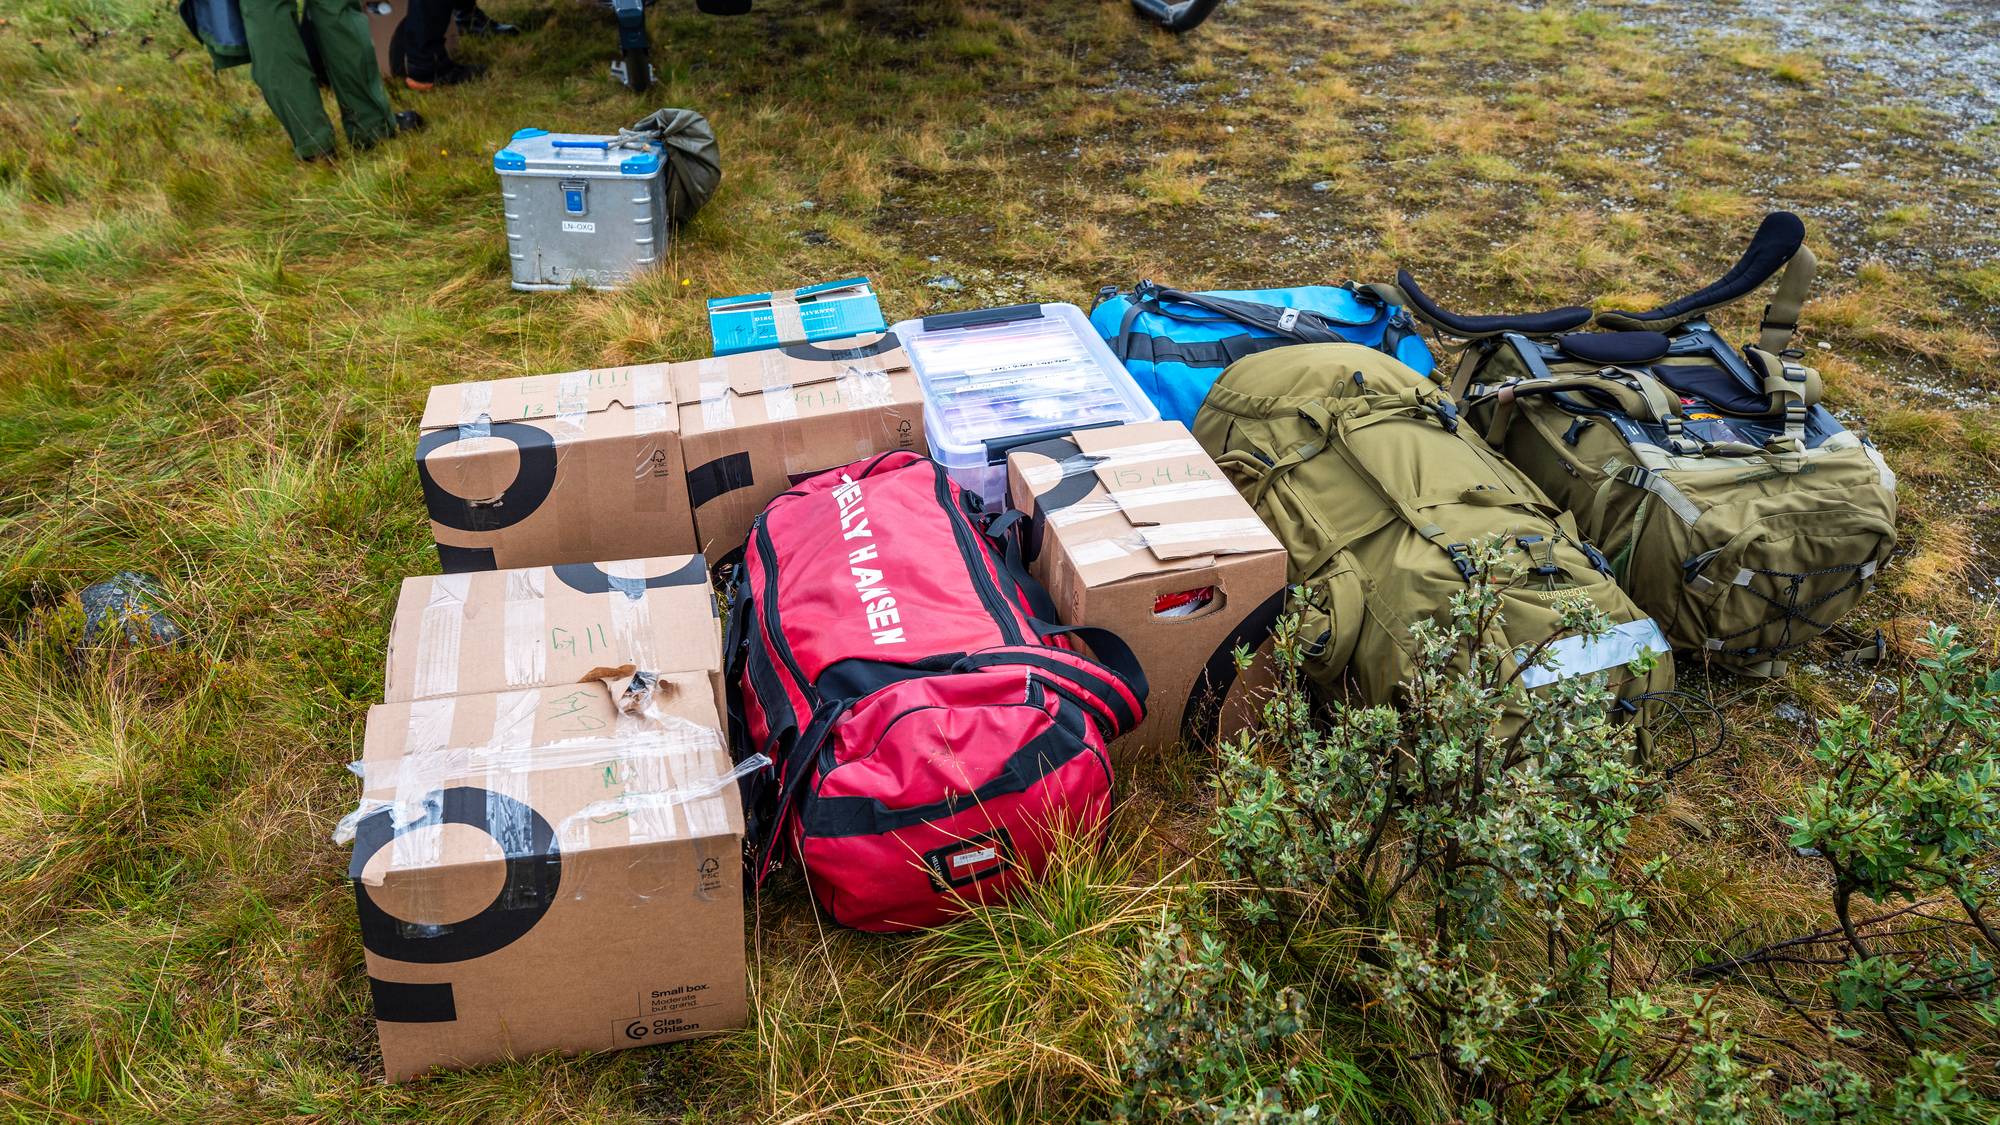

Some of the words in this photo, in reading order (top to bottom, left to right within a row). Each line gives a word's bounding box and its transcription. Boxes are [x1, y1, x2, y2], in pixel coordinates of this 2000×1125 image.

[849, 543, 907, 646] HANSEN
[651, 986, 683, 999] Small
[651, 994, 696, 1007] Moderate
[653, 1018, 683, 1028] Clas
[653, 1023, 700, 1035] Ohlson
